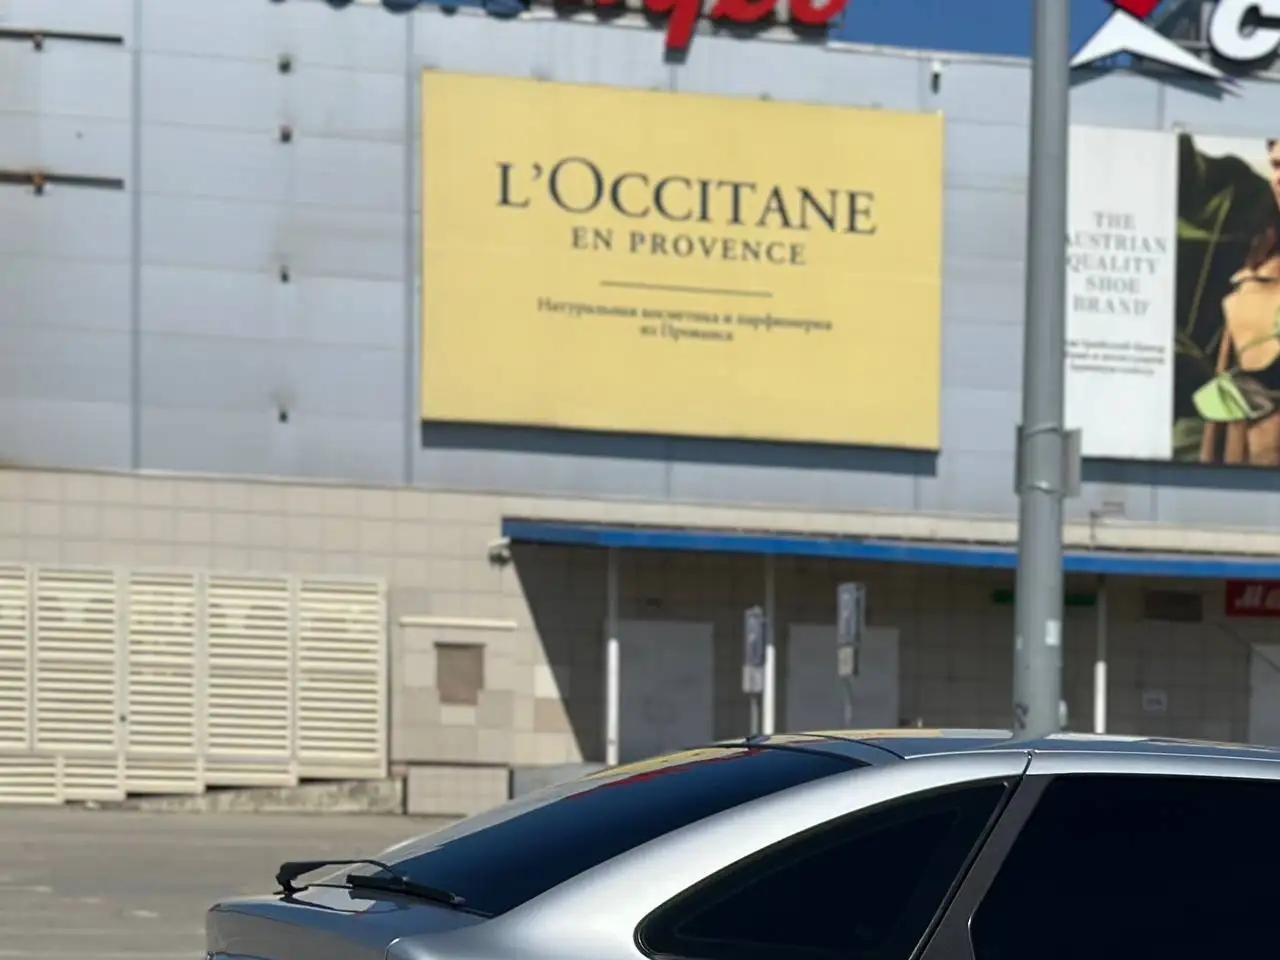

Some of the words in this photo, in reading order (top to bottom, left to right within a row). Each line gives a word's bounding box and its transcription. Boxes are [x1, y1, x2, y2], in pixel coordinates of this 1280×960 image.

[496, 156, 879, 236] L'OCCITANE
[1093, 210, 1136, 230] THE
[571, 226, 614, 250] EN
[629, 231, 807, 265] PROVENCE
[1085, 275, 1141, 295] SHOE
